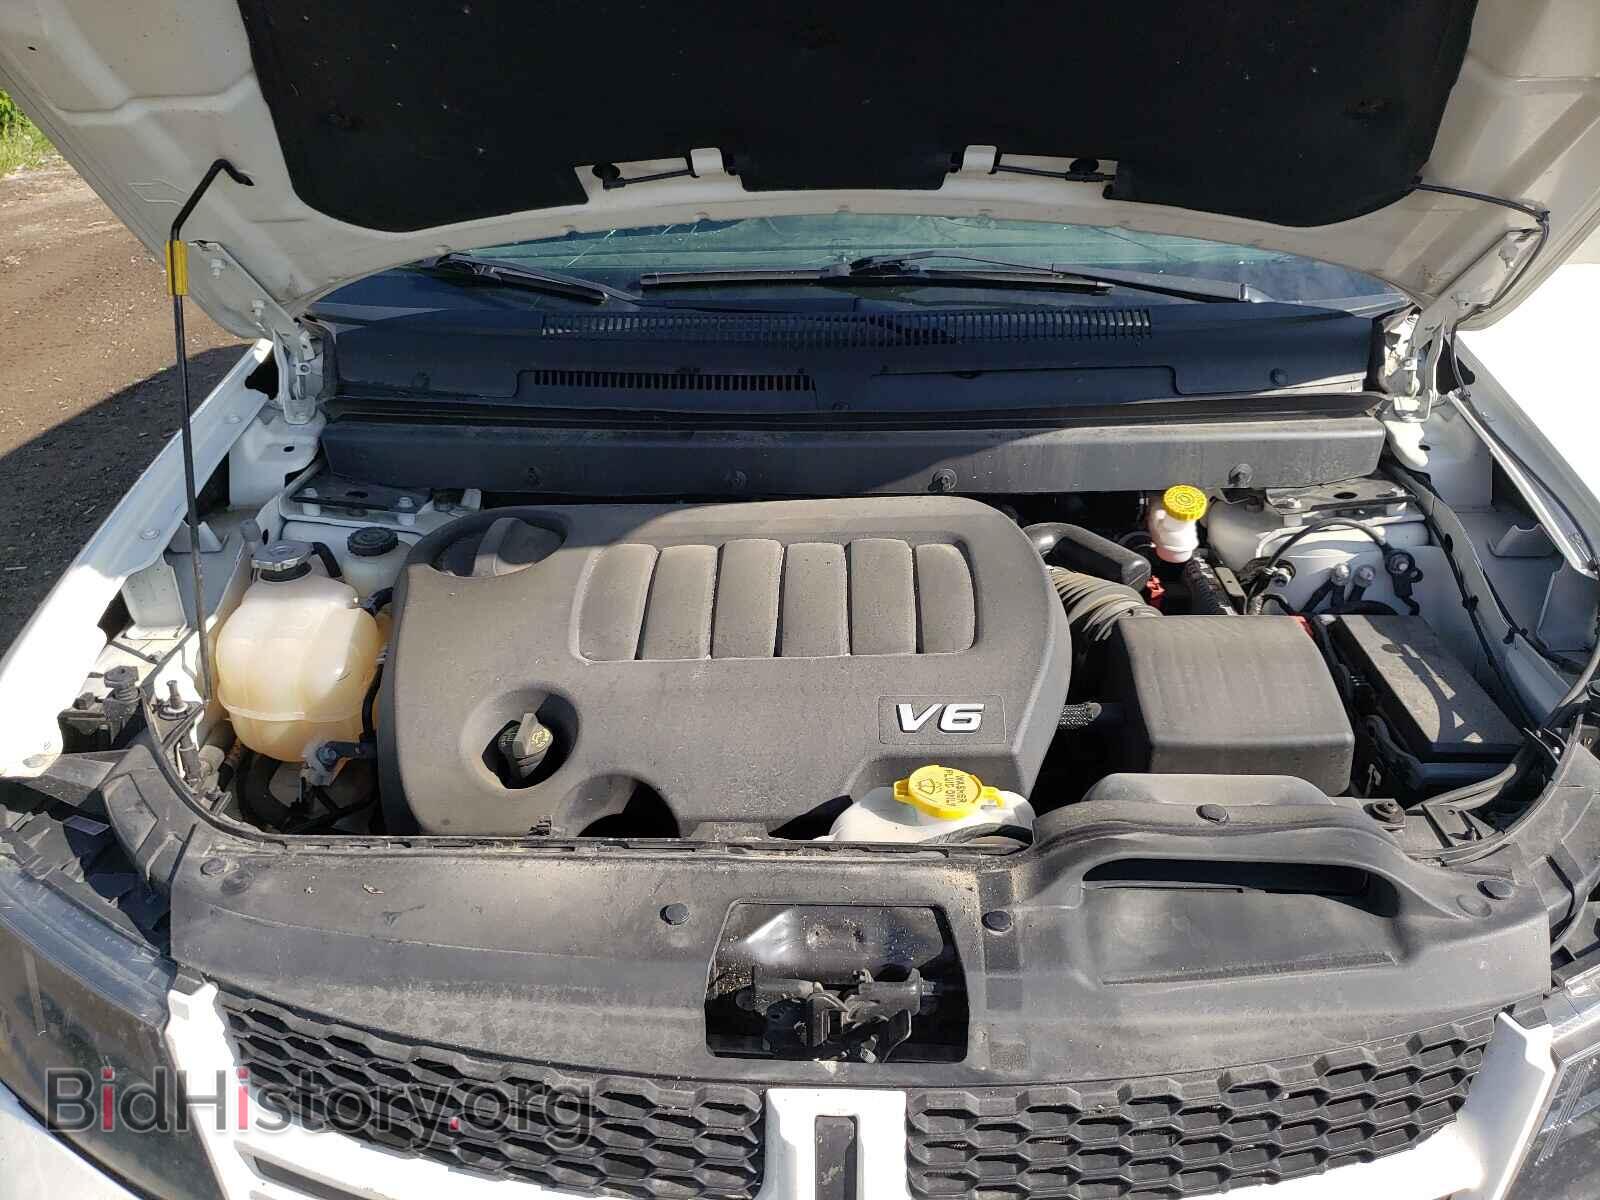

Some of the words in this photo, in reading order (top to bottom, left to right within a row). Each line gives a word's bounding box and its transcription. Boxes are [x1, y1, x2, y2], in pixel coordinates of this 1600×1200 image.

[895, 703, 986, 733] V6
[944, 769, 954, 788] FLUID
[955, 775, 967, 803] WASHER
[945, 789, 958, 807] ONLY
